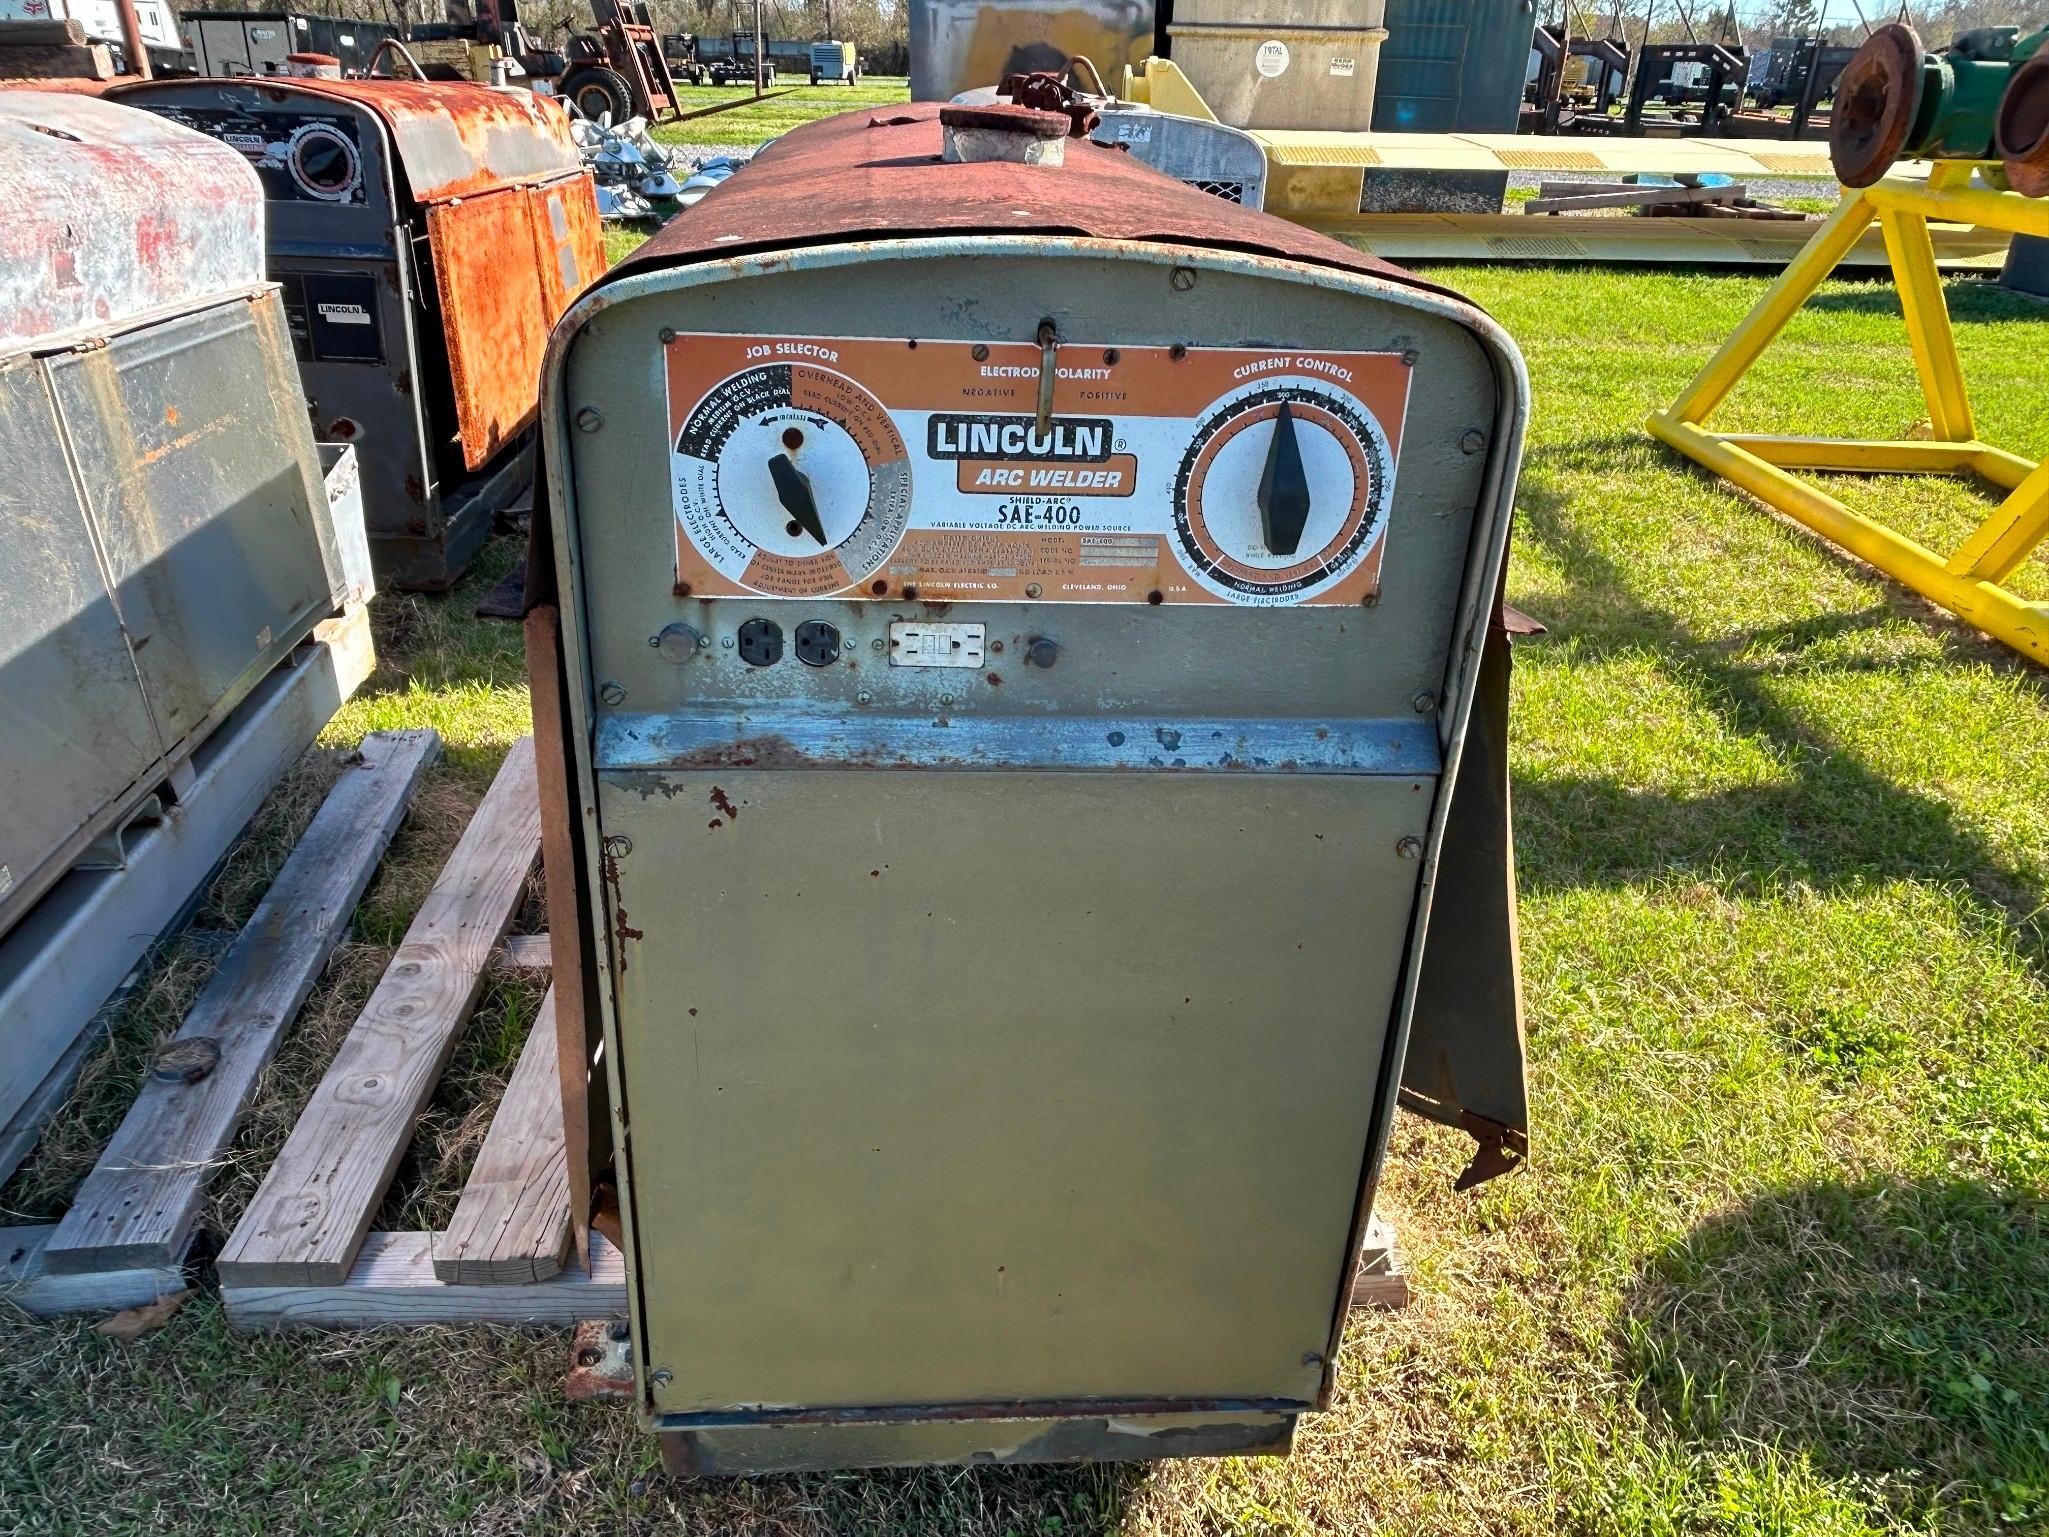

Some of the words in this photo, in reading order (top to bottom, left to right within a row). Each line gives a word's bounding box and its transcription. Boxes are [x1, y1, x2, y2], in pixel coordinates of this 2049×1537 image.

[320, 305, 360, 314] LINCOLN
[746, 344, 772, 359] JOB
[775, 343, 839, 362] SELECTOR
[981, 366, 1040, 378] ELECTROD
[1233, 357, 1291, 379] CURRENT
[1296, 357, 1353, 382] CONTROL
[689, 397, 721, 435] NORMAL
[723, 372, 767, 397] WELDING
[962, 388, 1015, 397] NEGATIVE
[1080, 391, 1127, 400] POSITIVE
[798, 370, 853, 394] OVERHEAD
[855, 394, 875, 412] AND
[876, 413, 903, 456] VERTICAL
[937, 422, 1103, 456] LINCOLN
[975, 468, 1025, 486] ARC
[1030, 469, 1122, 488] WELDER
[899, 471, 909, 511] SPECIAL
[678, 477, 701, 535] ELECTRODES
[997, 504, 1081, 524] SAE-400
[930, 521, 966, 529] VARIABLE
[969, 522, 1004, 530] VOLTAGE
[699, 536, 725, 564] LARGE
[862, 513, 905, 571] APPLICATIONS
